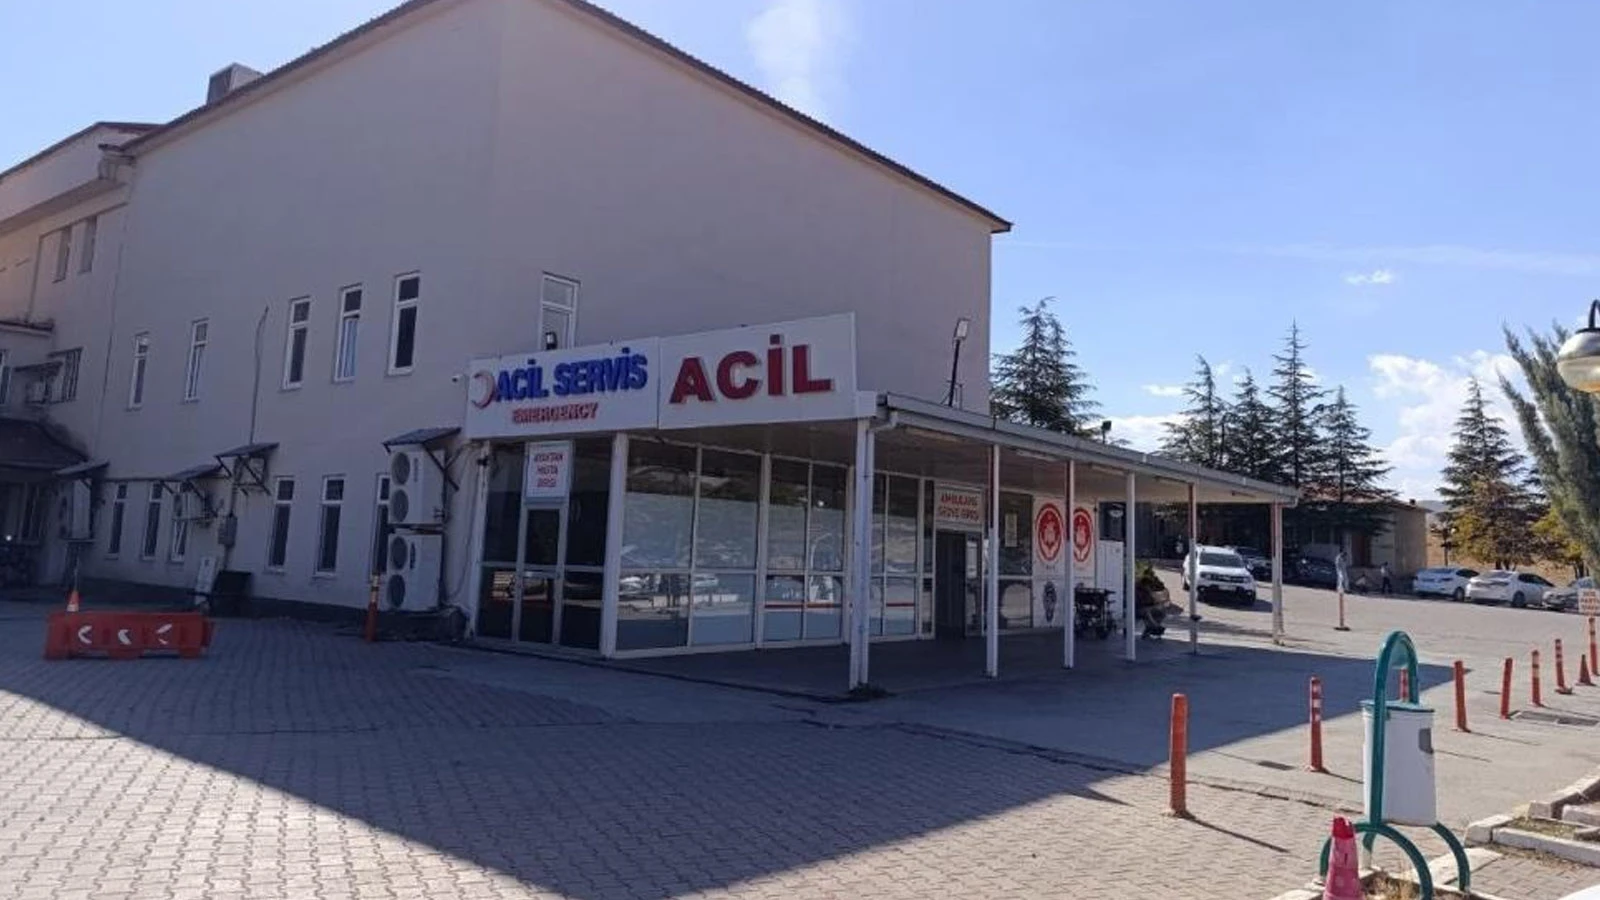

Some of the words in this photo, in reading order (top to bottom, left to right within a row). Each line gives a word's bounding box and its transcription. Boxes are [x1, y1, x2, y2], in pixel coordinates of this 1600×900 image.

[496, 358, 549, 402] ACİL
[553, 347, 648, 396] SERVİS
[668, 334, 832, 404] ACİL
[512, 402, 599, 424] EMERGENCY
